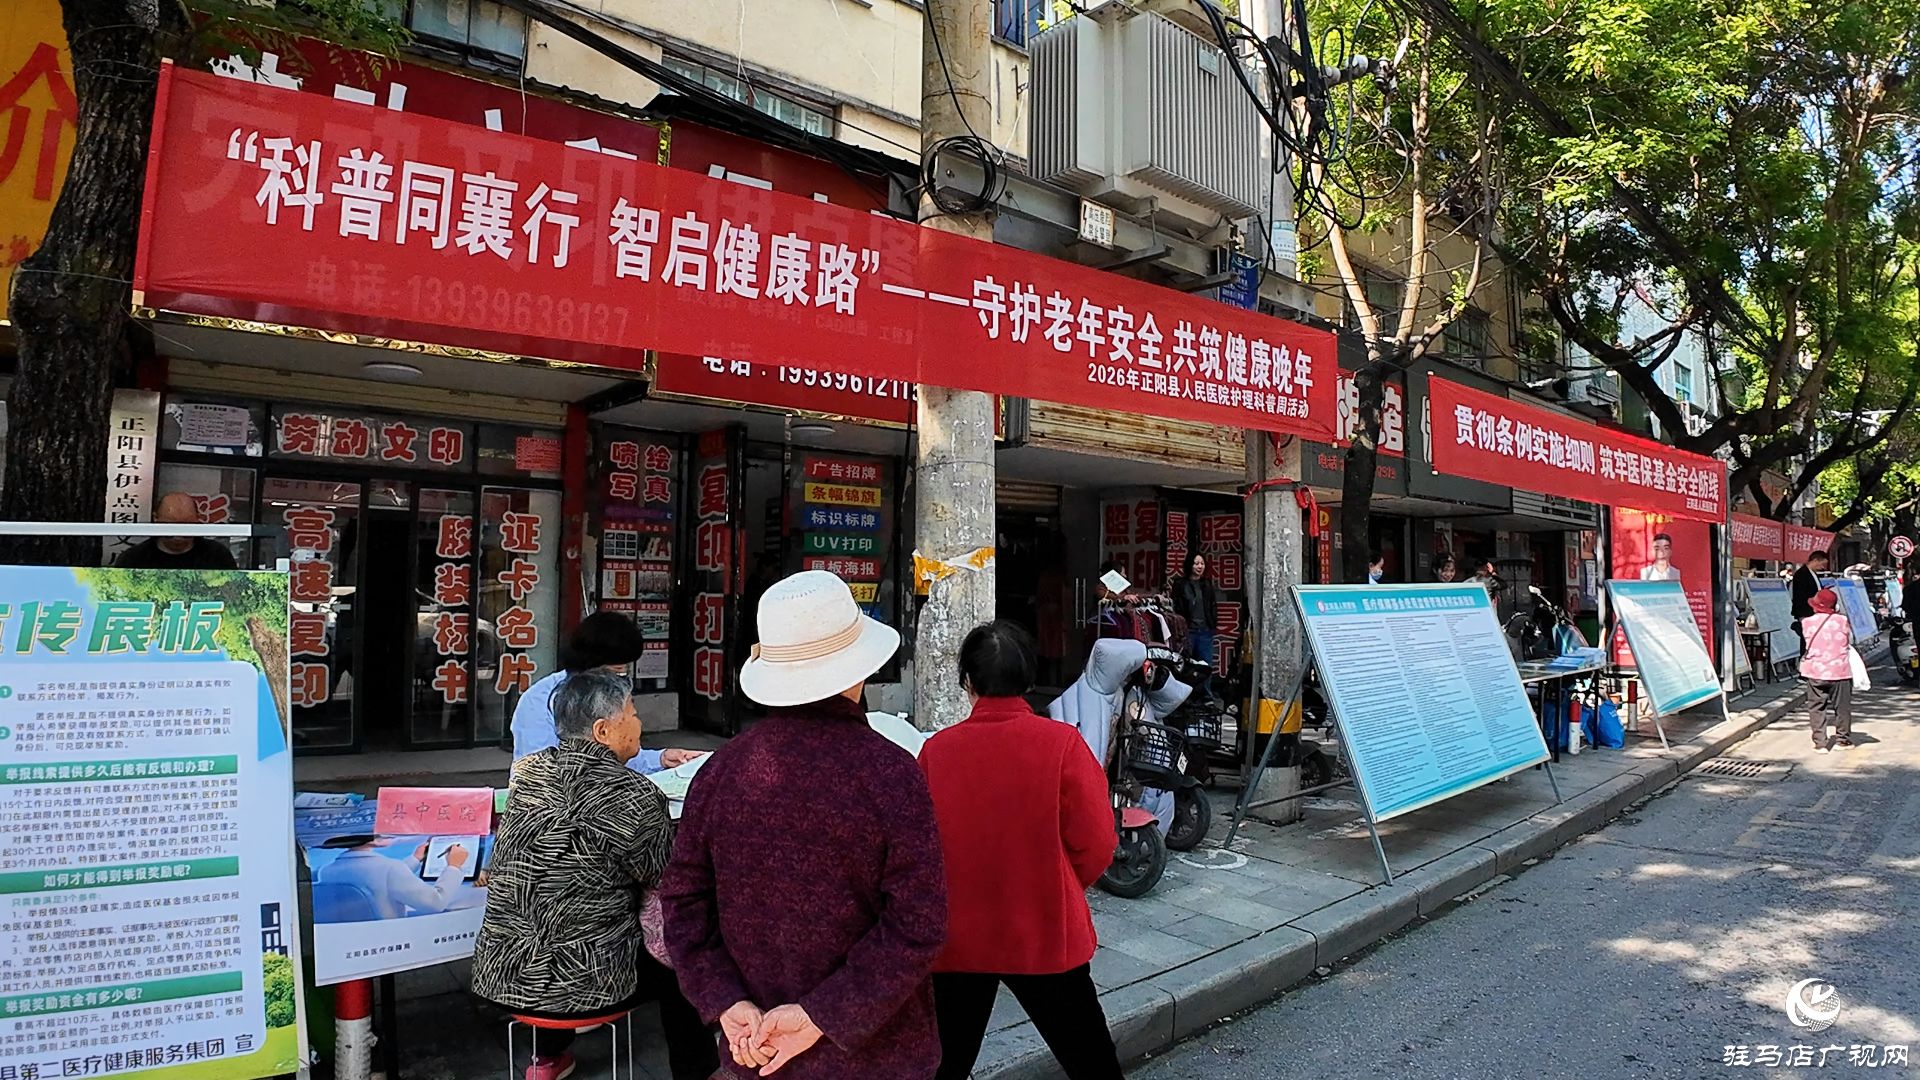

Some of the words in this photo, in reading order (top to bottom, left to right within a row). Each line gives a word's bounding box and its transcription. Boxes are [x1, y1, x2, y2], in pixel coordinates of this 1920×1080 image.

[227, 128, 580, 269] “科普同襄行
[1088, 362, 1311, 421] 2026年正阳县人民医院护理科普周活动
[282, 412, 464, 466] 劳动文印
[1454, 404, 1595, 475] 贯彻条例实施细则
[1598, 443, 1719, 502] 筑牢医保基金安全防线
[610, 441, 672, 472] 喷绘
[812, 462, 877, 480] 广告招牌
[609, 472, 671, 503] 写真
[811, 485, 876, 504] 条幅锦旗
[697, 463, 728, 572] 复印
[811, 510, 876, 528] 标识标牌
[813, 536, 873, 552] UV打印
[811, 560, 875, 576] 展板海报
[285, 507, 335, 708] 高速复印
[433, 514, 473, 703] 胶装标书
[495, 511, 542, 695] 证卡名片
[0, 600, 224, 655] 传展板
[693, 592, 725, 700] 打印
[0, 789, 238, 810] 15个工作日内反馈，对符合受理范围的举报案件，医疗保障
[392, 802, 477, 823] 县中医院
[0, 813, 229, 833] 实名举报案件，告知举报人不予受理的意见，并说明原因。
[0, 834, 238, 857] 起30个工作日内办理完毕。情况复杂的，视情况可以延
[0, 846, 227, 868] 至3个月内办结。特别重大案件，原则上不超过6个月。
[0, 918, 77, 932] 免医保基金损失；
[0, 937, 241, 969] 构、定点零售药店内部人员或原内部人员的，可适当提高
[0, 948, 242, 981] 励标准；举报人为定点医疗机构、定点零售药店竞争机构
[0, 960, 232, 993] 其工作人员，并提供可靠线索的，也将适当提高奖励标准。
[0, 1037, 225, 1080] 县第二医疗健康服务集团
[235, 1034, 254, 1053] 宣
